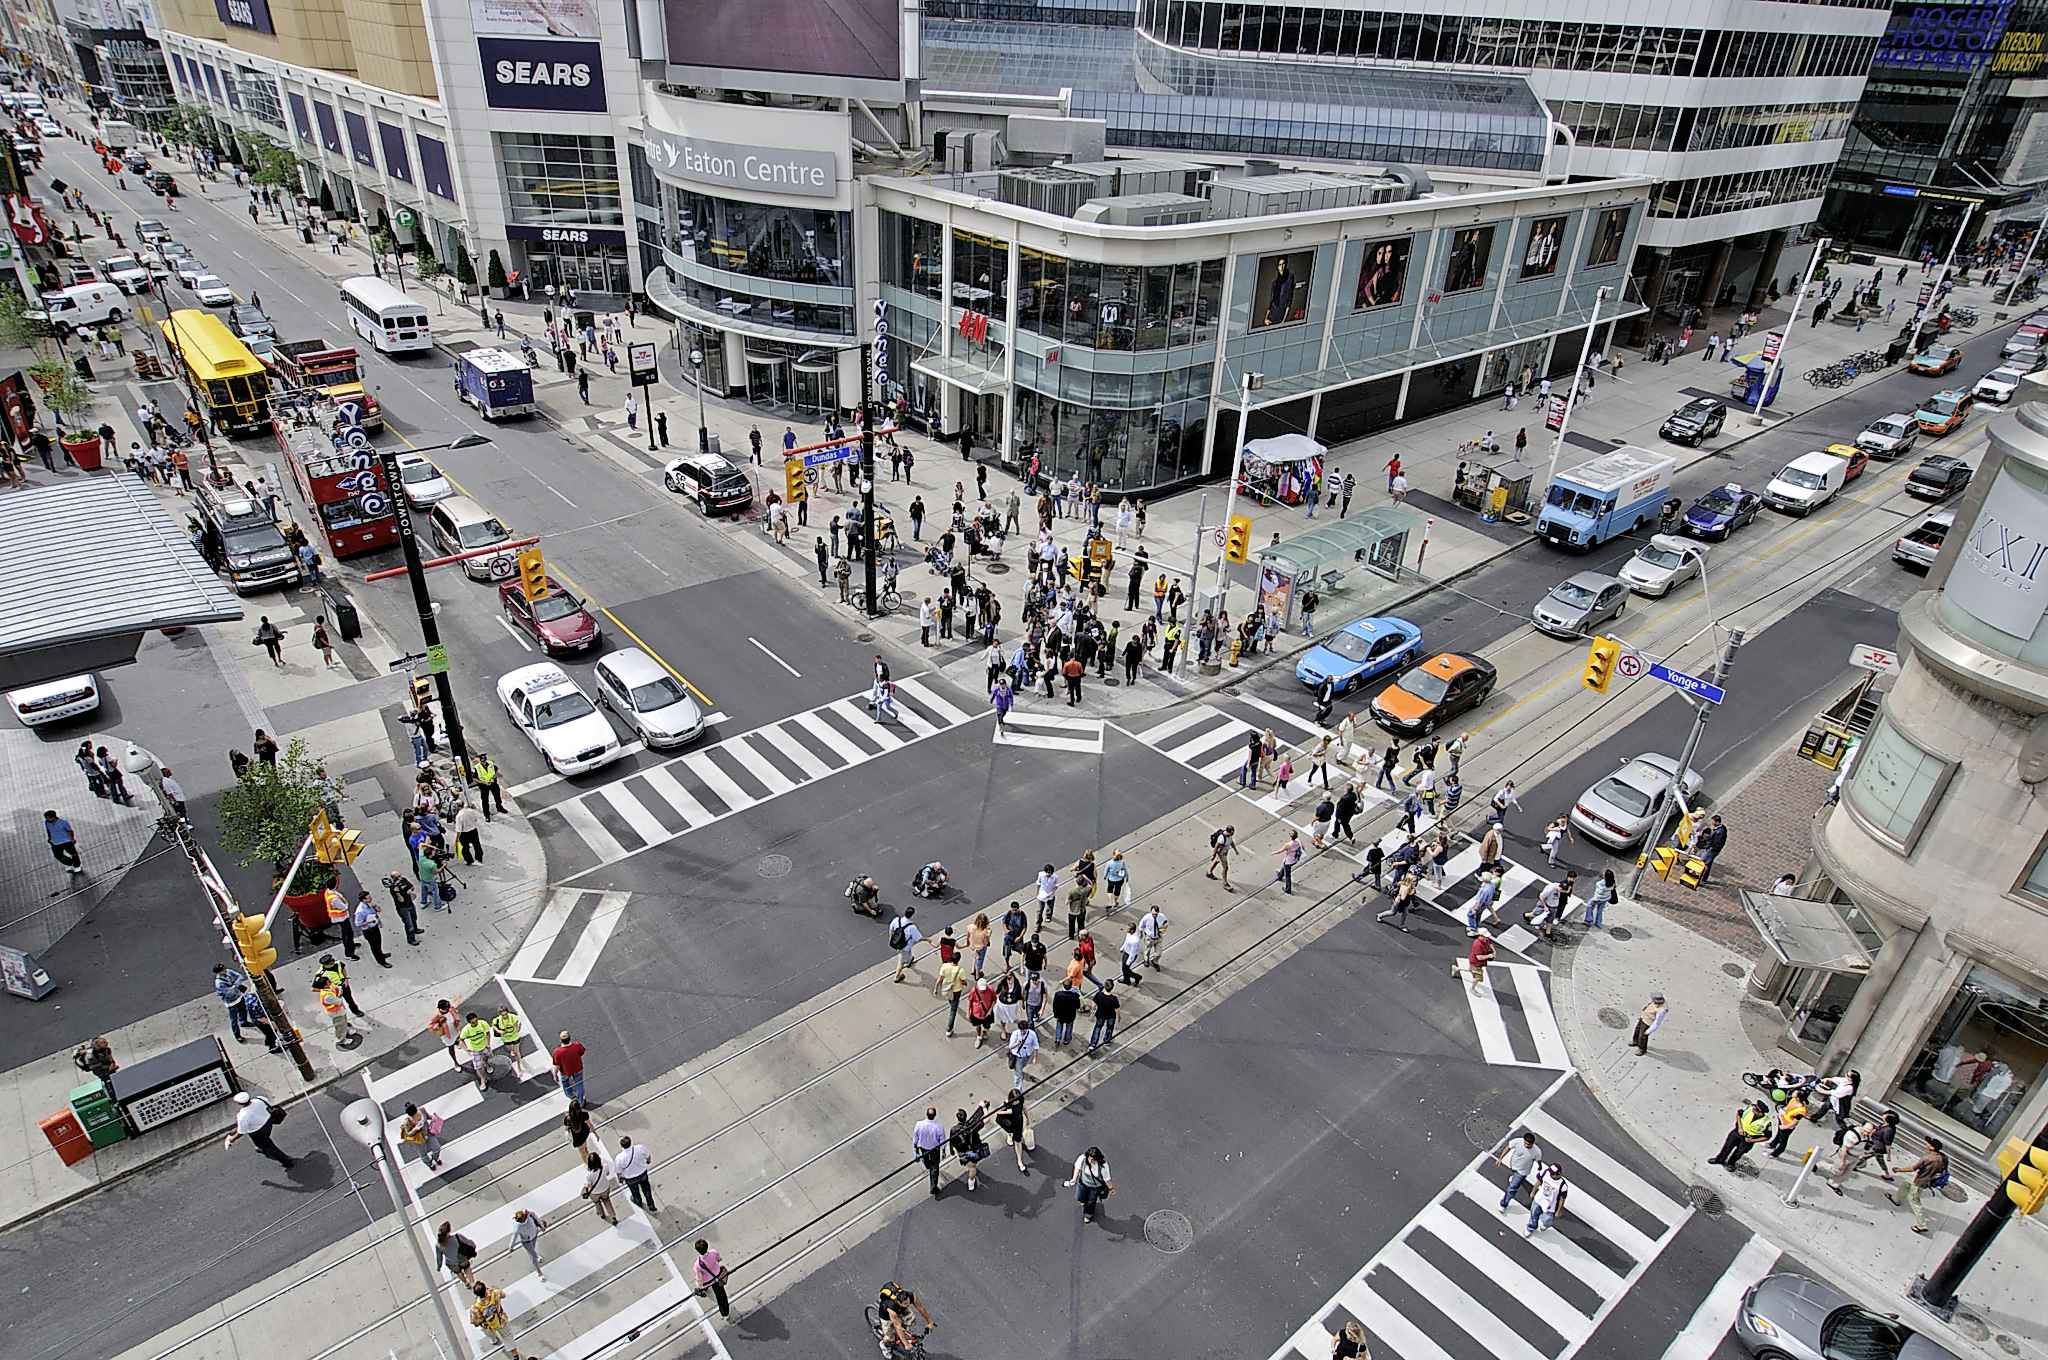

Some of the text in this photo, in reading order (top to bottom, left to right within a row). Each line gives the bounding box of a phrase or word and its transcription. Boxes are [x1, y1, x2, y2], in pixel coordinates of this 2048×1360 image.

[2001, 31, 2045, 52] RYERSON
[496, 59, 591, 87] SEARS
[1991, 52, 2045, 73] UNIVERSITY
[684, 146, 825, 186] Eaton Centre
[542, 229, 588, 243] SEARS
[959, 309, 988, 350] H&M
[338, 402, 386, 515] Yonge
[812, 451, 838, 463] Dundas
[386, 461, 412, 536] DOWNTOWN
[1666, 669, 1698, 690] Yonge
